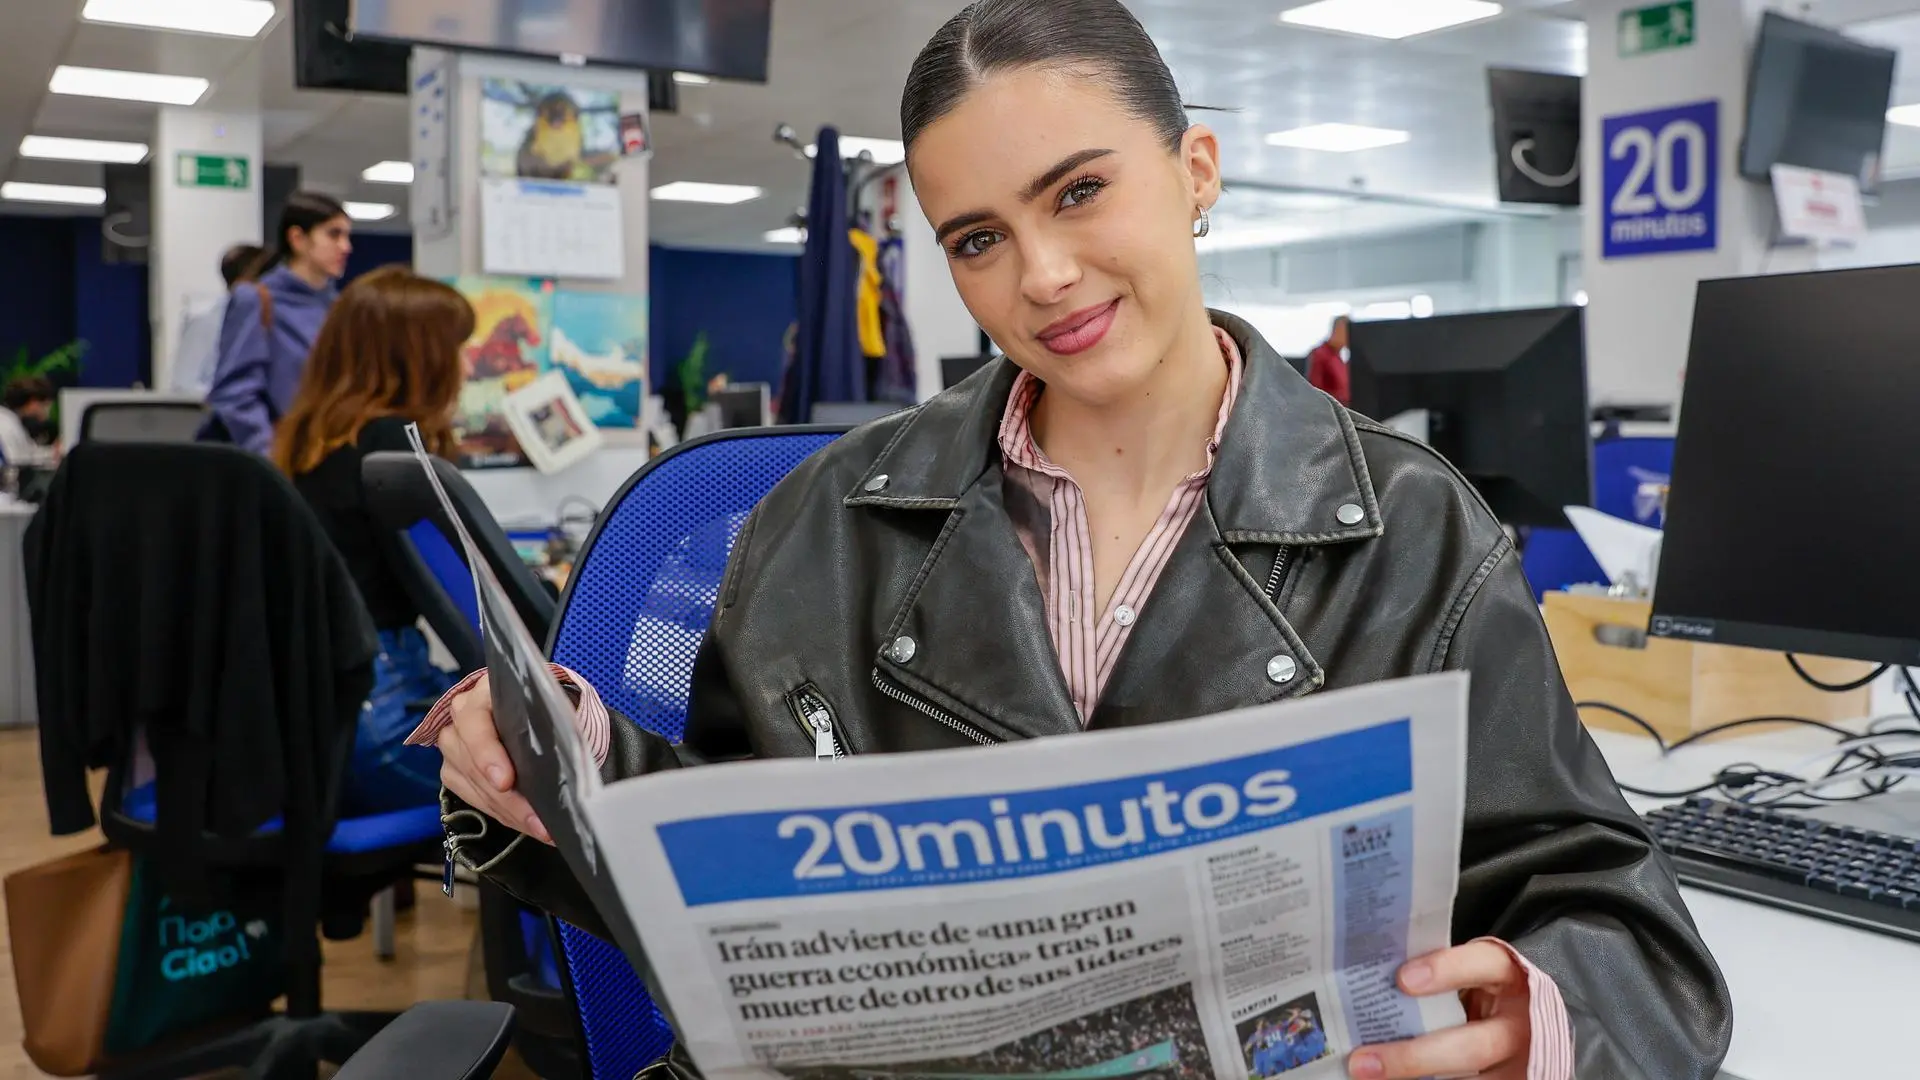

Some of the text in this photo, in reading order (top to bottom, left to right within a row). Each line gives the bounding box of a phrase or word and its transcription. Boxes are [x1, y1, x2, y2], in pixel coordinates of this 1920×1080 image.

[1609, 119, 1708, 215] 20
[1610, 211, 1707, 243] minutos
[778, 768, 1298, 880] 20minutos
[161, 932, 251, 981] Ciao!
[716, 936, 786, 964] Irán
[791, 922, 926, 959] advierte
[930, 921, 971, 947] de
[976, 915, 1057, 942] «una
[1061, 899, 1137, 933] gran
[728, 967, 835, 998] guerra
[838, 948, 1031, 984] económica»
[1037, 932, 1100, 961] tras
[1105, 924, 1134, 946] la
[739, 992, 855, 1022] muerte
[859, 987, 898, 1011] de
[902, 981, 970, 1006] otro
[974, 975, 1014, 999] de
[1018, 965, 1072, 990] sus
[1076, 933, 1184, 974] líderes
